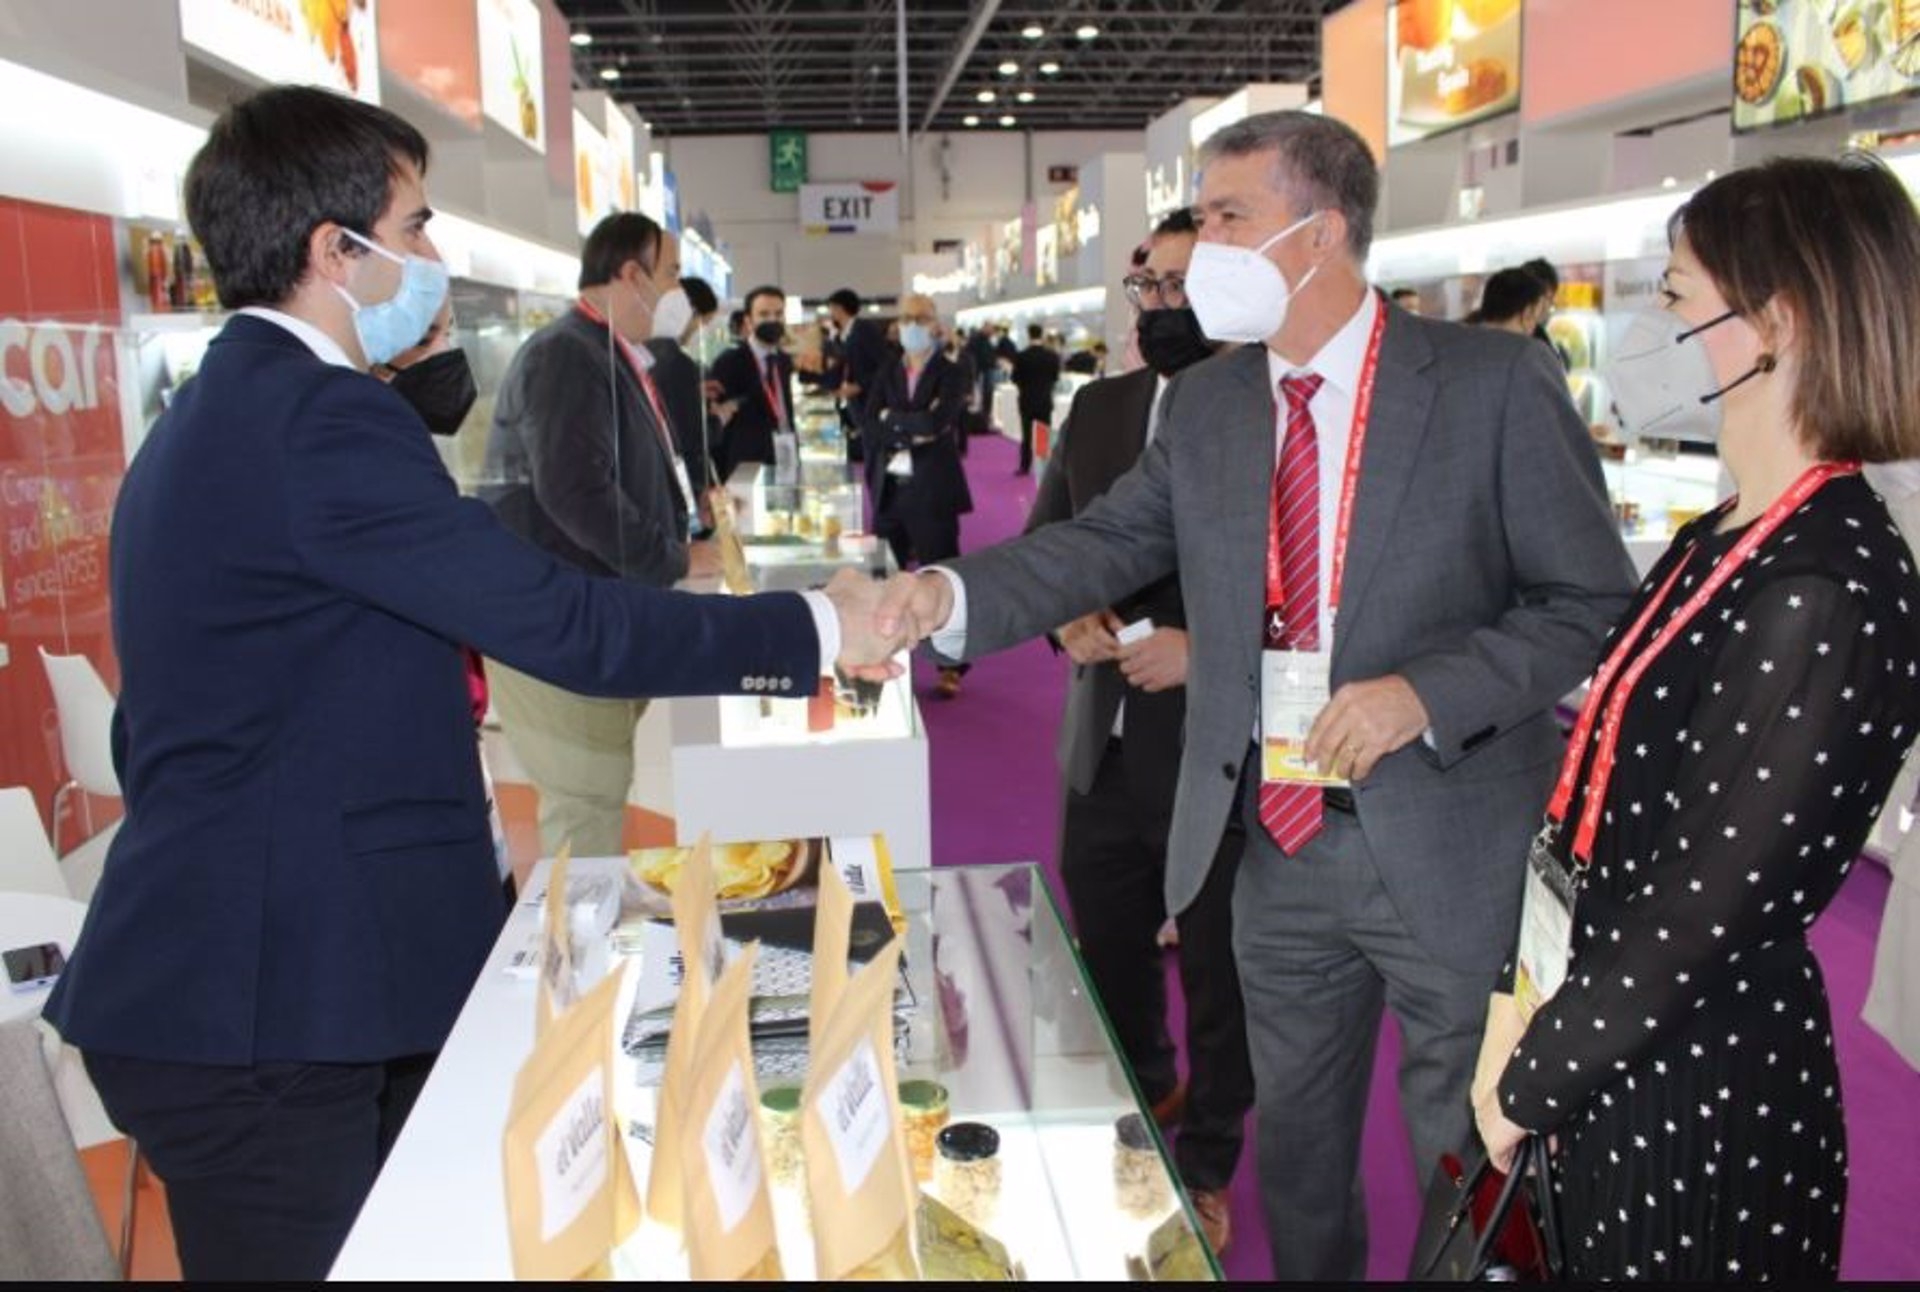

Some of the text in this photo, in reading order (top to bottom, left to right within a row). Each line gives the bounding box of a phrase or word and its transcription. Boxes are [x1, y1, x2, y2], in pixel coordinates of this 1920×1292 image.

[823, 196, 873, 220] EXIT
[14, 568, 60, 605] since
[60, 543, 100, 587] 1955
